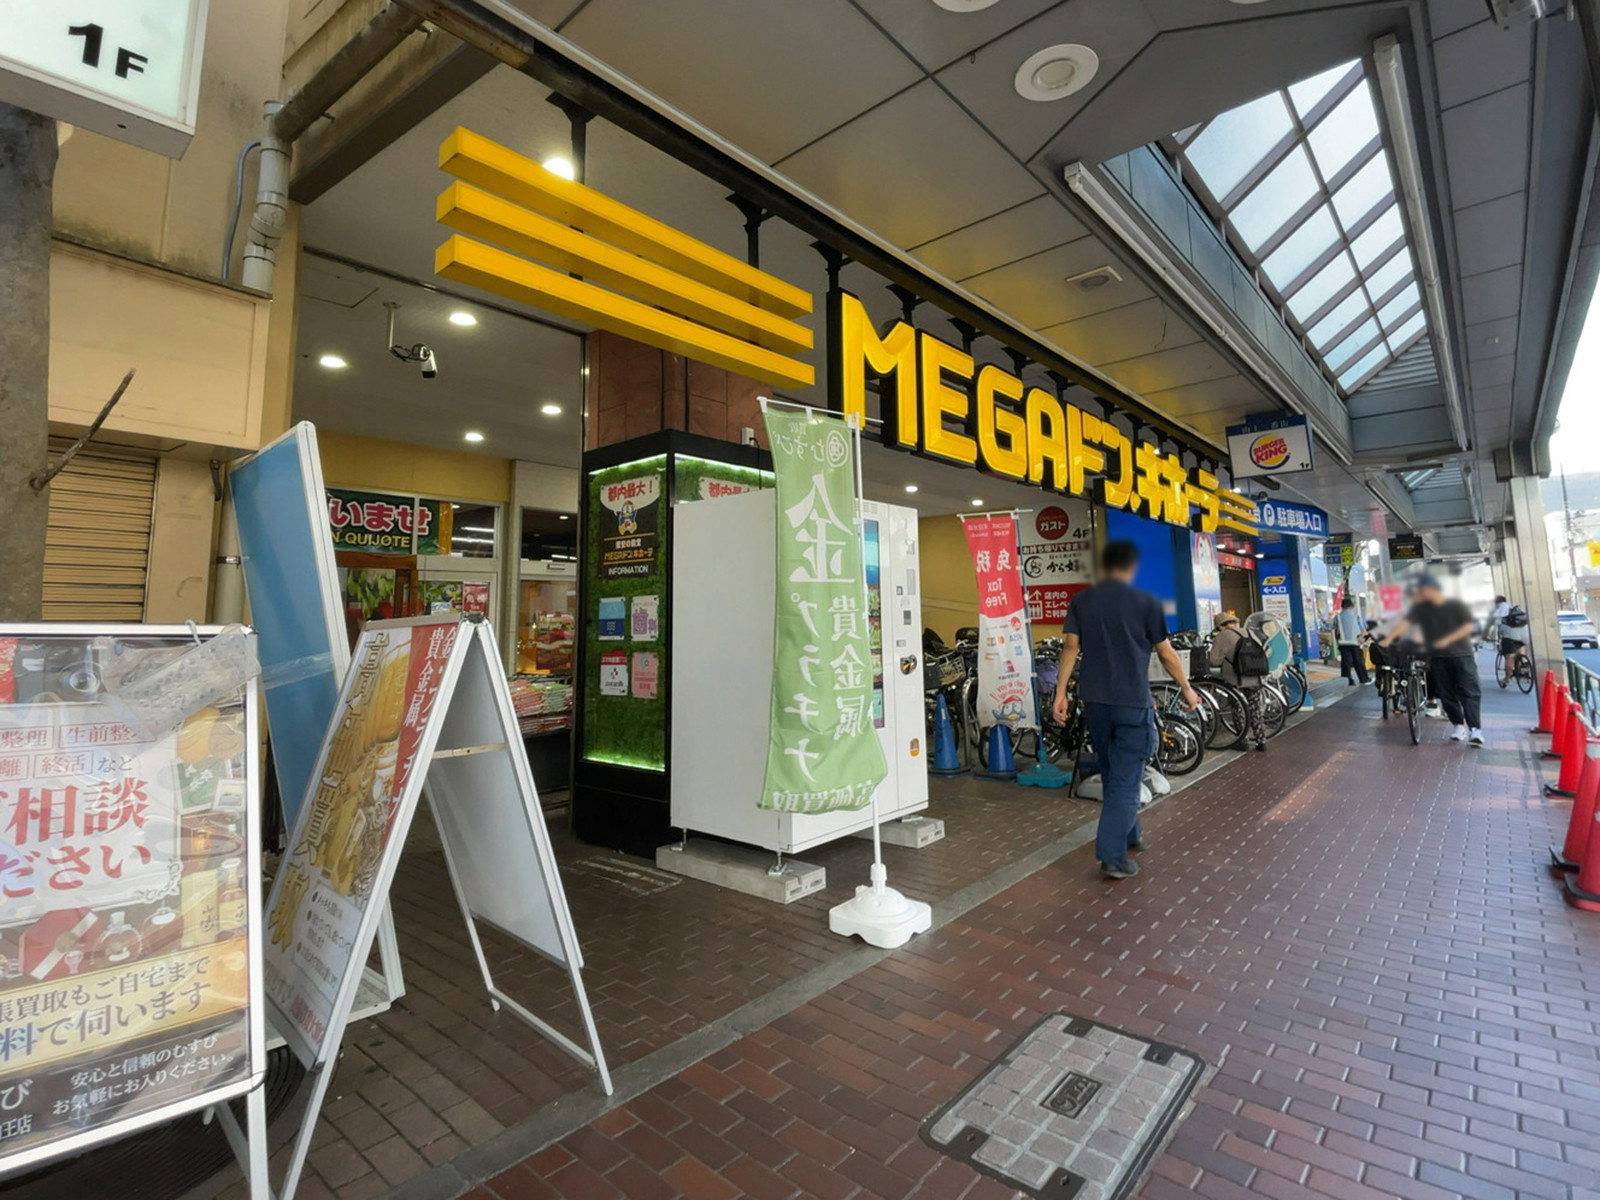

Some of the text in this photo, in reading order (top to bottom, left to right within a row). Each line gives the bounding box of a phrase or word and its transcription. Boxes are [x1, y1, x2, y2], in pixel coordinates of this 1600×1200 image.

[68, 22, 149, 79] 1F
[1253, 437, 1286, 455] BURGER
[1255, 445, 1288, 464] KING
[708, 482, 744, 498] 都内最
[329, 498, 432, 537] いませ
[1040, 520, 1067, 532] ガスト
[1276, 506, 1323, 533] 駐車場入口
[344, 531, 411, 549] QUIJOTE
[1072, 527, 1090, 539] 4F
[608, 564, 650, 576] INFORMATION
[1272, 585, 1288, 594] 入口
[1044, 600, 1070, 609] エレベ
[403, 627, 445, 727] 貴金属
[0, 730, 49, 748] 整理
[66, 725, 138, 745] 生前整
[41, 755, 86, 773] 終活
[0, 777, 151, 846] 相談
[70, 1032, 220, 1091] 安心と信頼のむすび
[52, 1052, 235, 1116] お気軽にお入りください。
[0, 1113, 33, 1141] 王店
